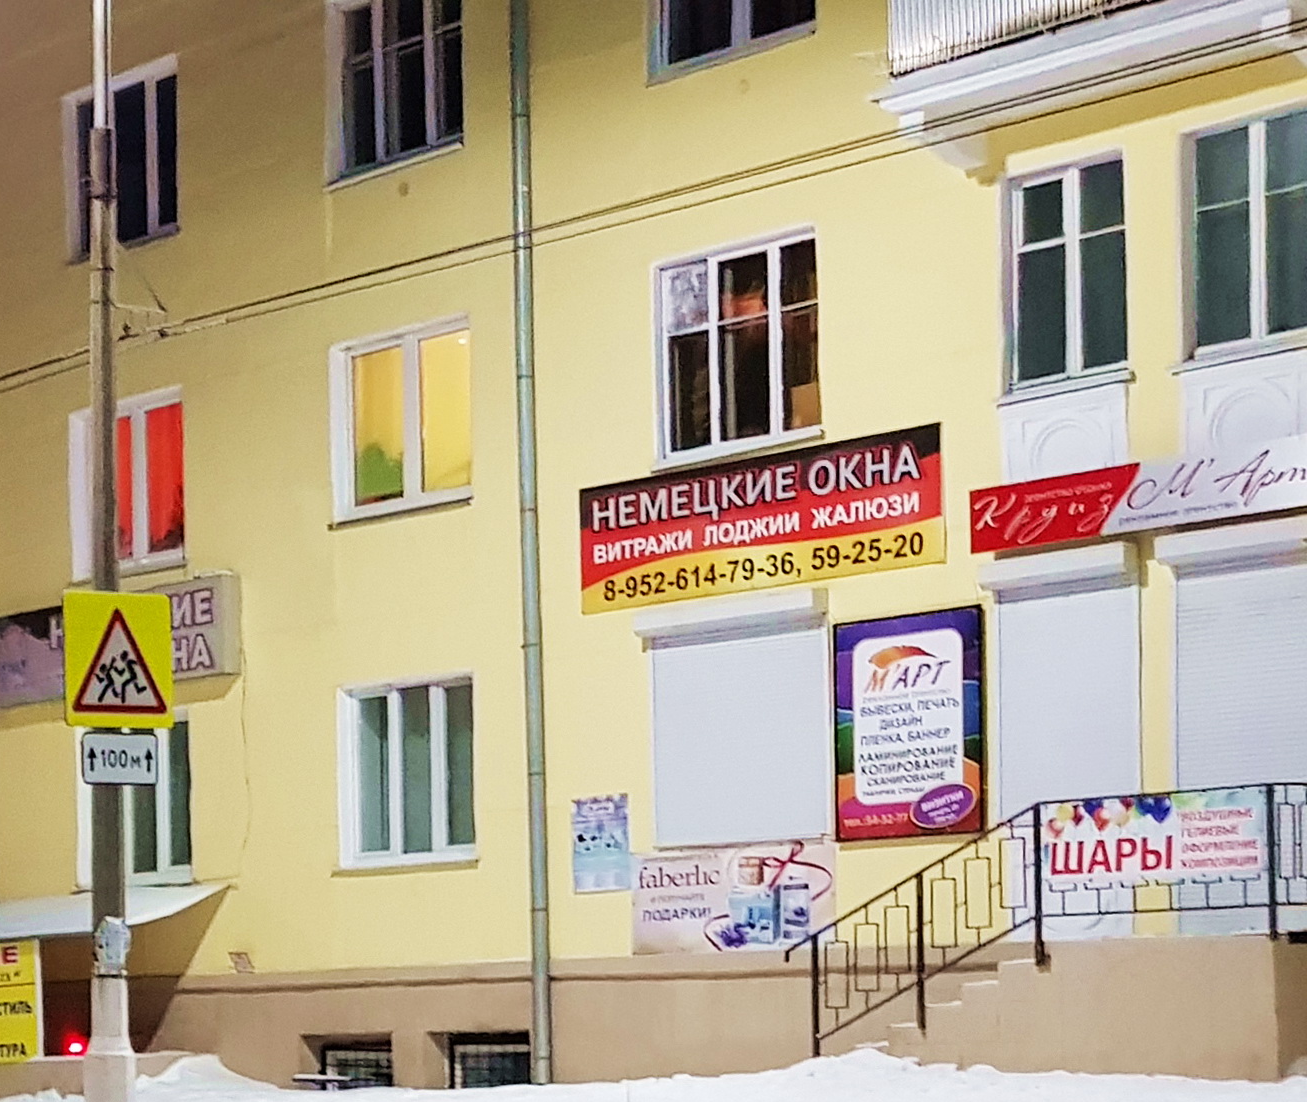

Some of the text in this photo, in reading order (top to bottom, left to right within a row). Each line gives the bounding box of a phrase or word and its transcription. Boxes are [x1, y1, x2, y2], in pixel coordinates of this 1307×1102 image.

[592, 445, 920, 532] НЕМЕЦКИЕ ОКНА
[593, 492, 919, 565] ВИТРАЖИ ЛОДЖИИ ЖАЛЮЗИ
[603, 532, 924, 602] 8-952-614-79-36, 59-25-20
[917, 697, 960, 711] ПЕЧАТЬ
[879, 715, 923, 731] ДИЗАЙН
[861, 756, 956, 776] КОПИРОВАНИЕ
[867, 771, 946, 787] СКАНИРОВАНИЕ
[1050, 835, 1173, 875] ШАРЫ
[639, 864, 720, 889] faberlic
